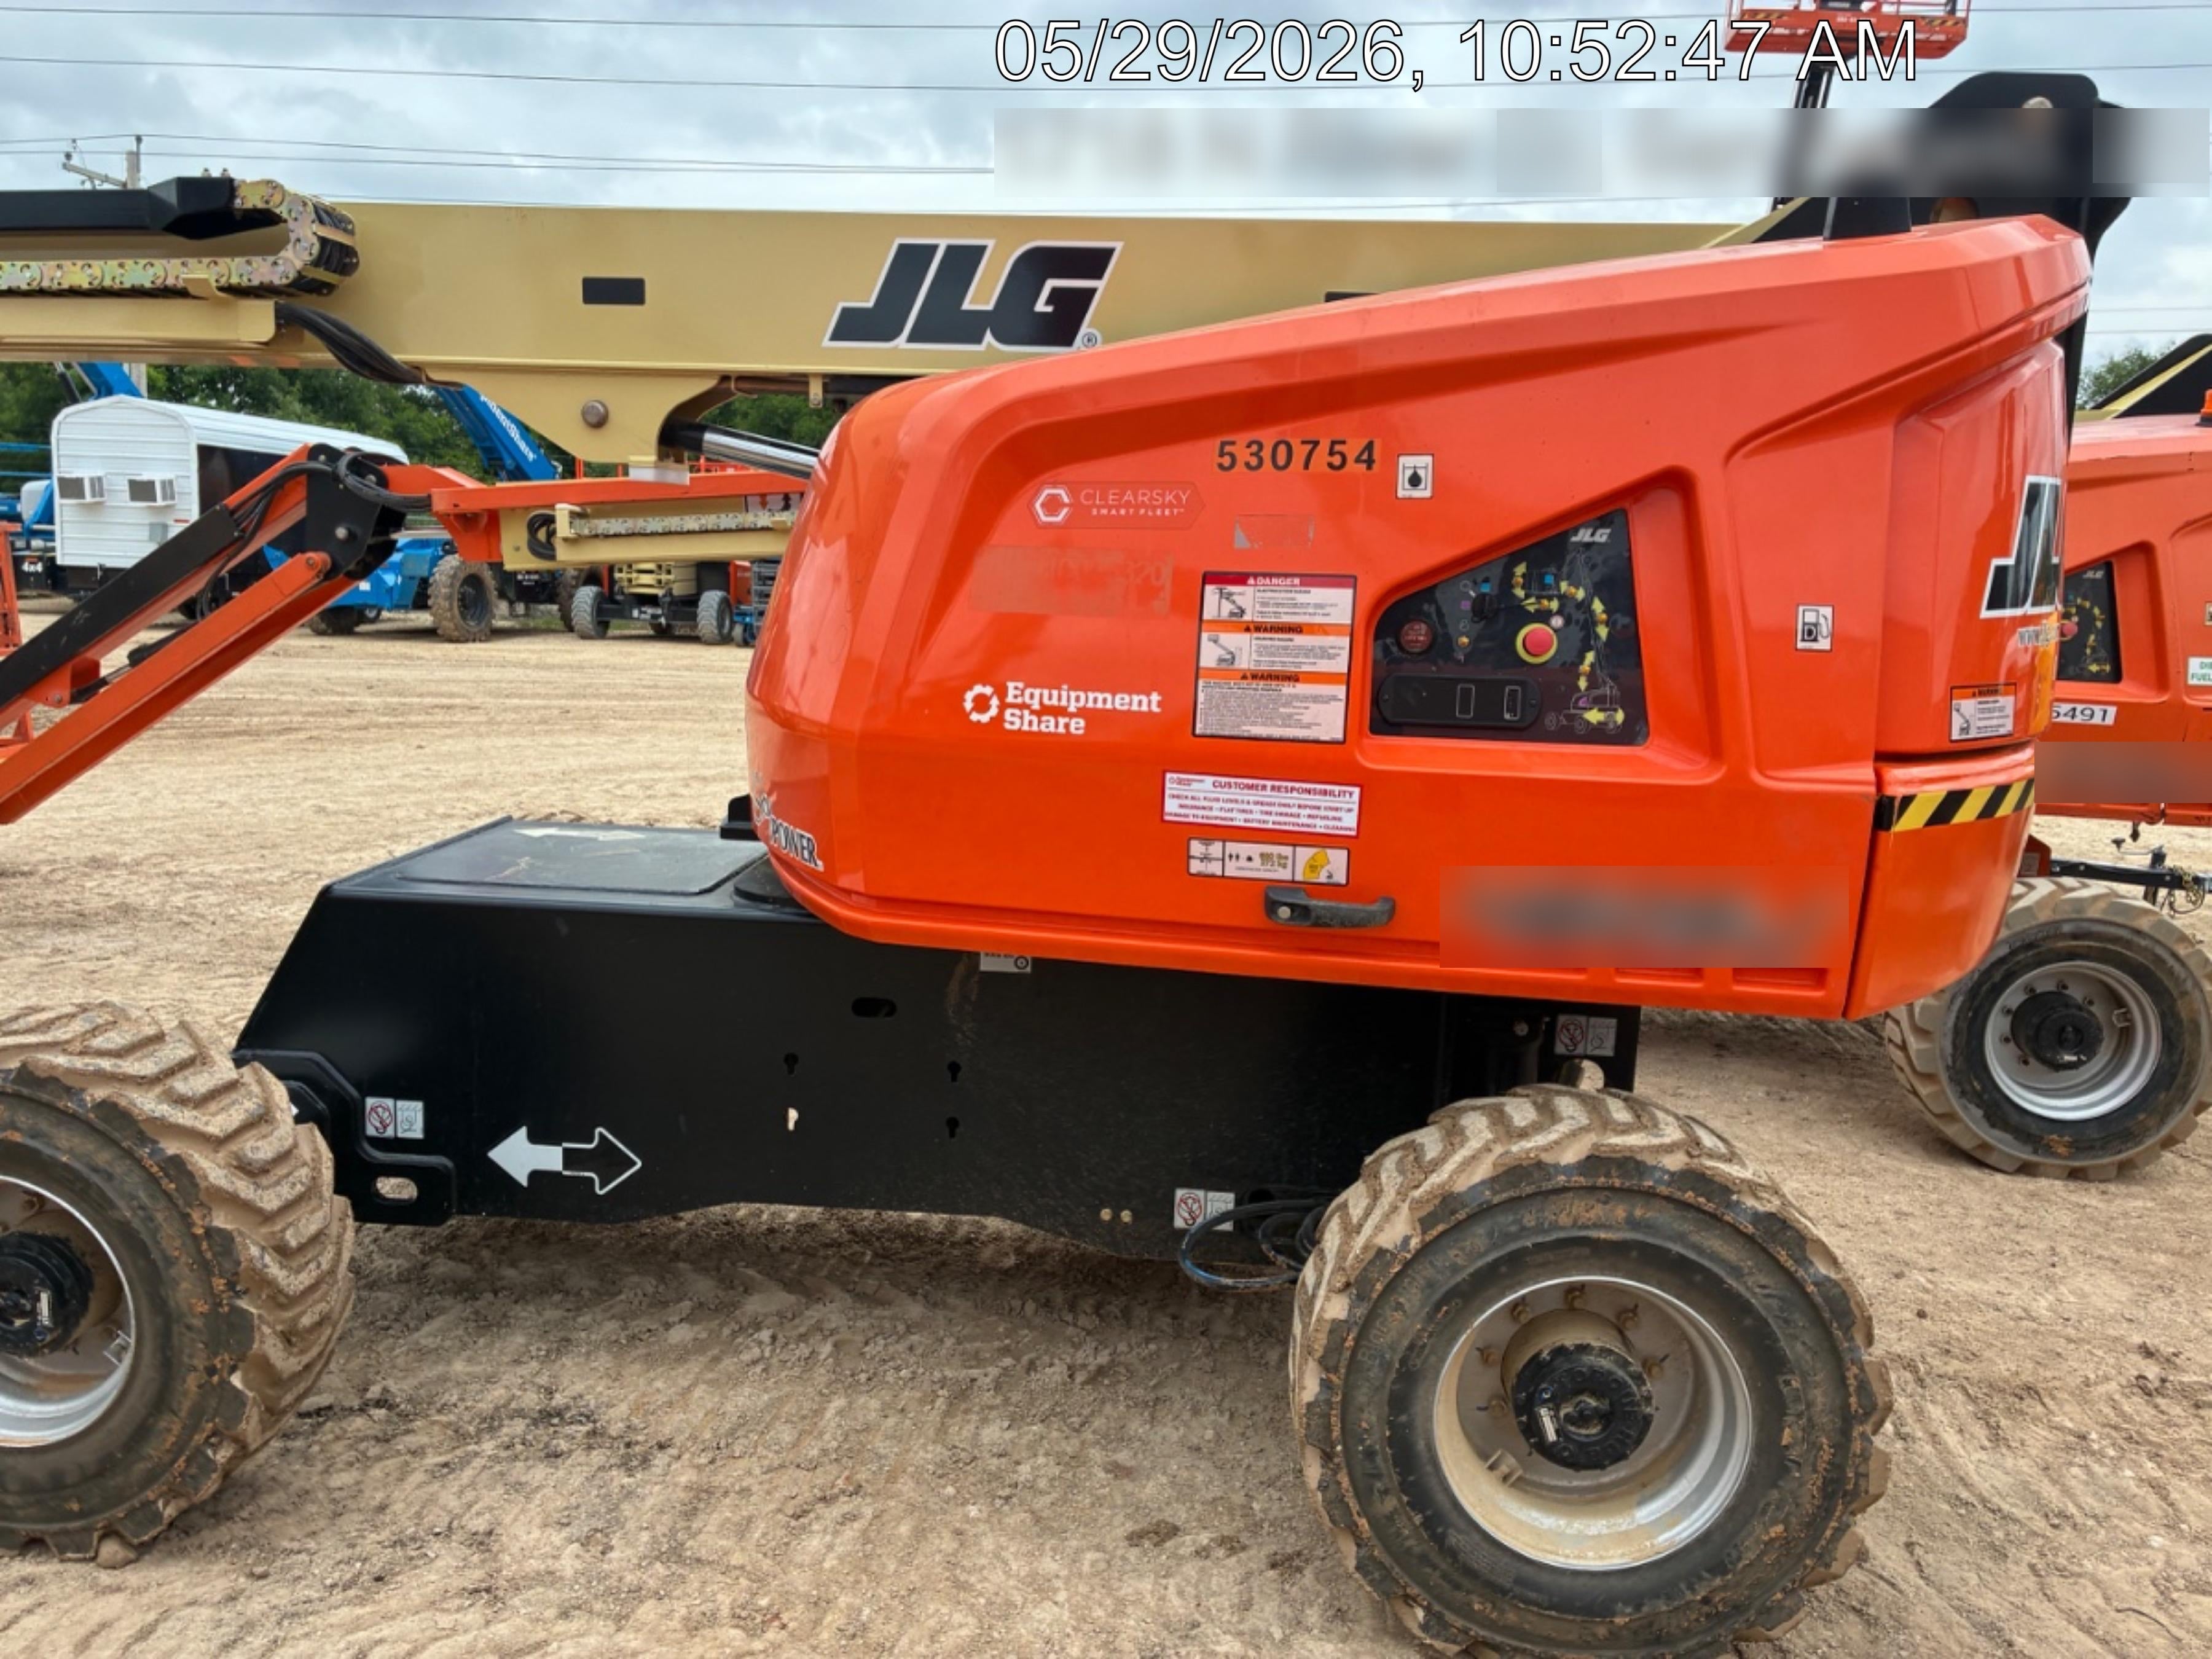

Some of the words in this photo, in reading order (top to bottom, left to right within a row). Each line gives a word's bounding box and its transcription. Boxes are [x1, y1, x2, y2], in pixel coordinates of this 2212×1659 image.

[1217, 439, 1376, 472] 530754
[1080, 489, 1191, 505] CLEARSKY
[1570, 528, 1612, 543] JLG
[1257, 576, 1301, 586] DANGER
[1253, 624, 1304, 634] WARNING
[1251, 672, 1300, 683] WARNING
[1006, 681, 1162, 712] Equipment
[1003, 708, 1086, 735] Share
[1212, 780, 1267, 791] CUSTOMER
[1269, 784, 1354, 799] RESPONSIBILITY
